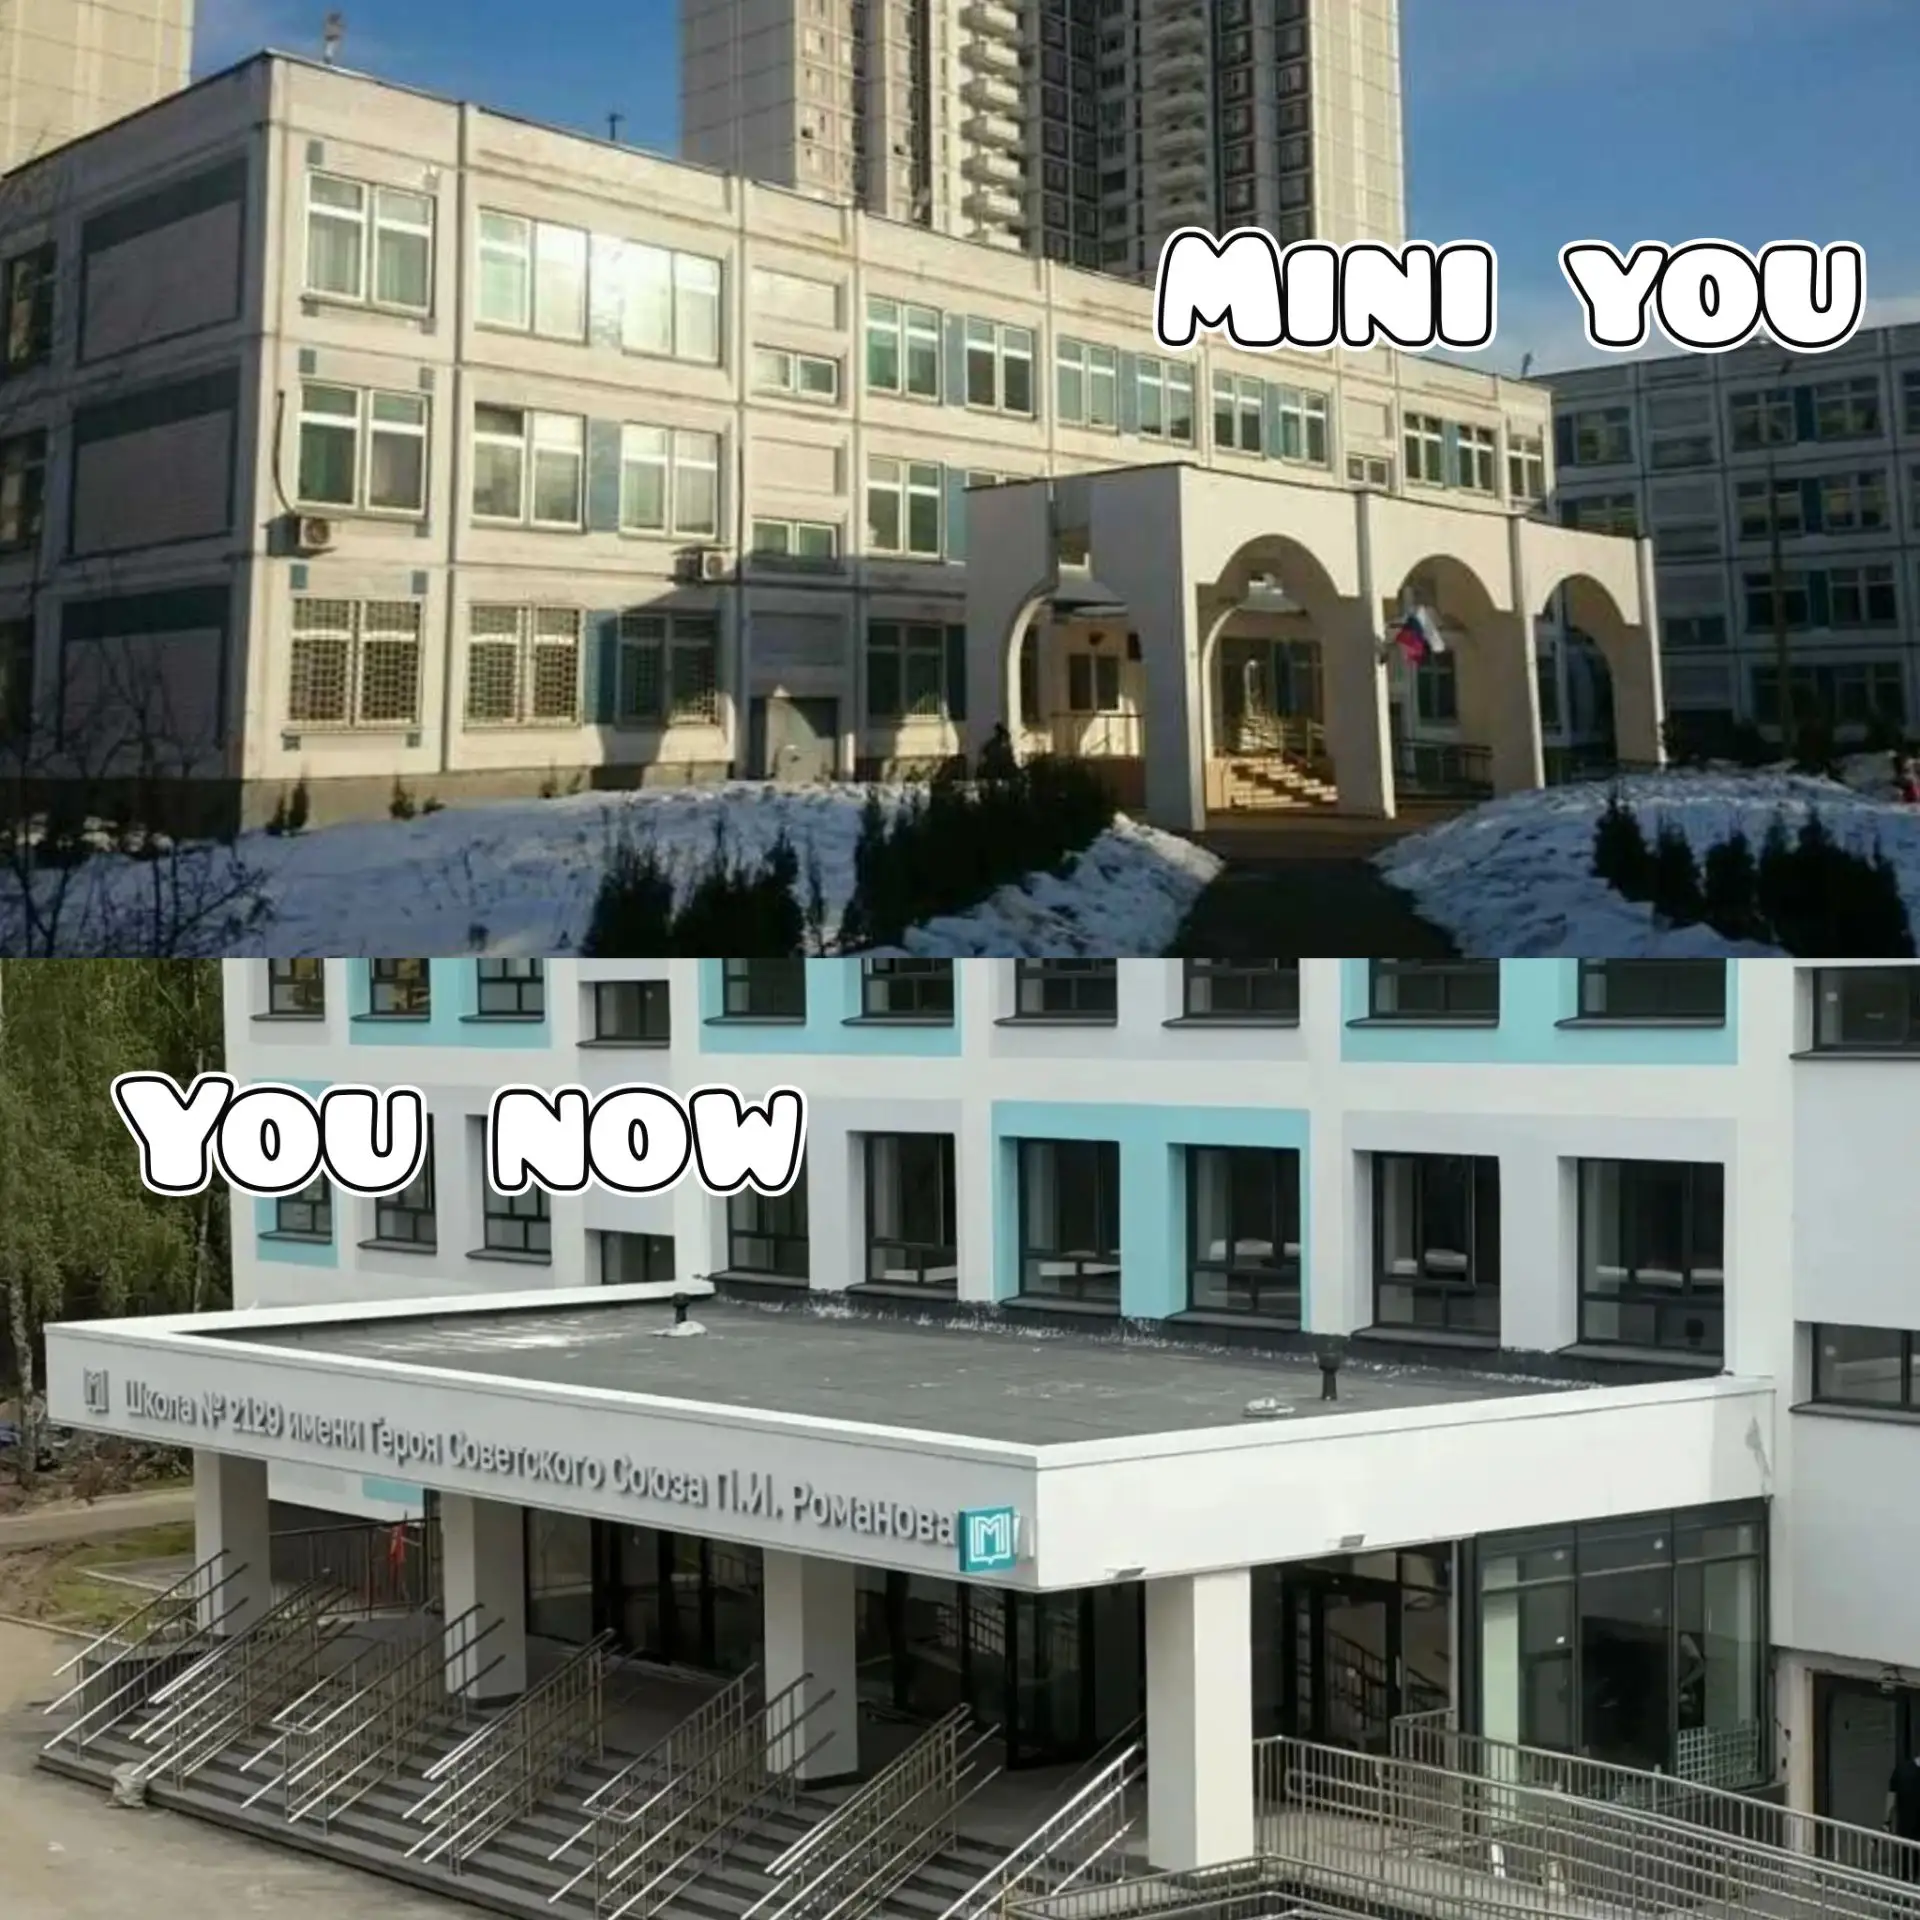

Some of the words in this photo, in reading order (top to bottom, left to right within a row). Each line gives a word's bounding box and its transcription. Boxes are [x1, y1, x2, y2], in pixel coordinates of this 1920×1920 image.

[126, 1379, 195, 1425] Школа
[199, 1393, 226, 1429] №
[232, 1398, 284, 1437] 2129
[290, 1412, 365, 1451] имени
[371, 1417, 442, 1466] Героя
[450, 1431, 605, 1488] Советского
[612, 1457, 707, 1507] Союза
[717, 1469, 783, 1518] П.И.
[793, 1482, 956, 1546] Романова
